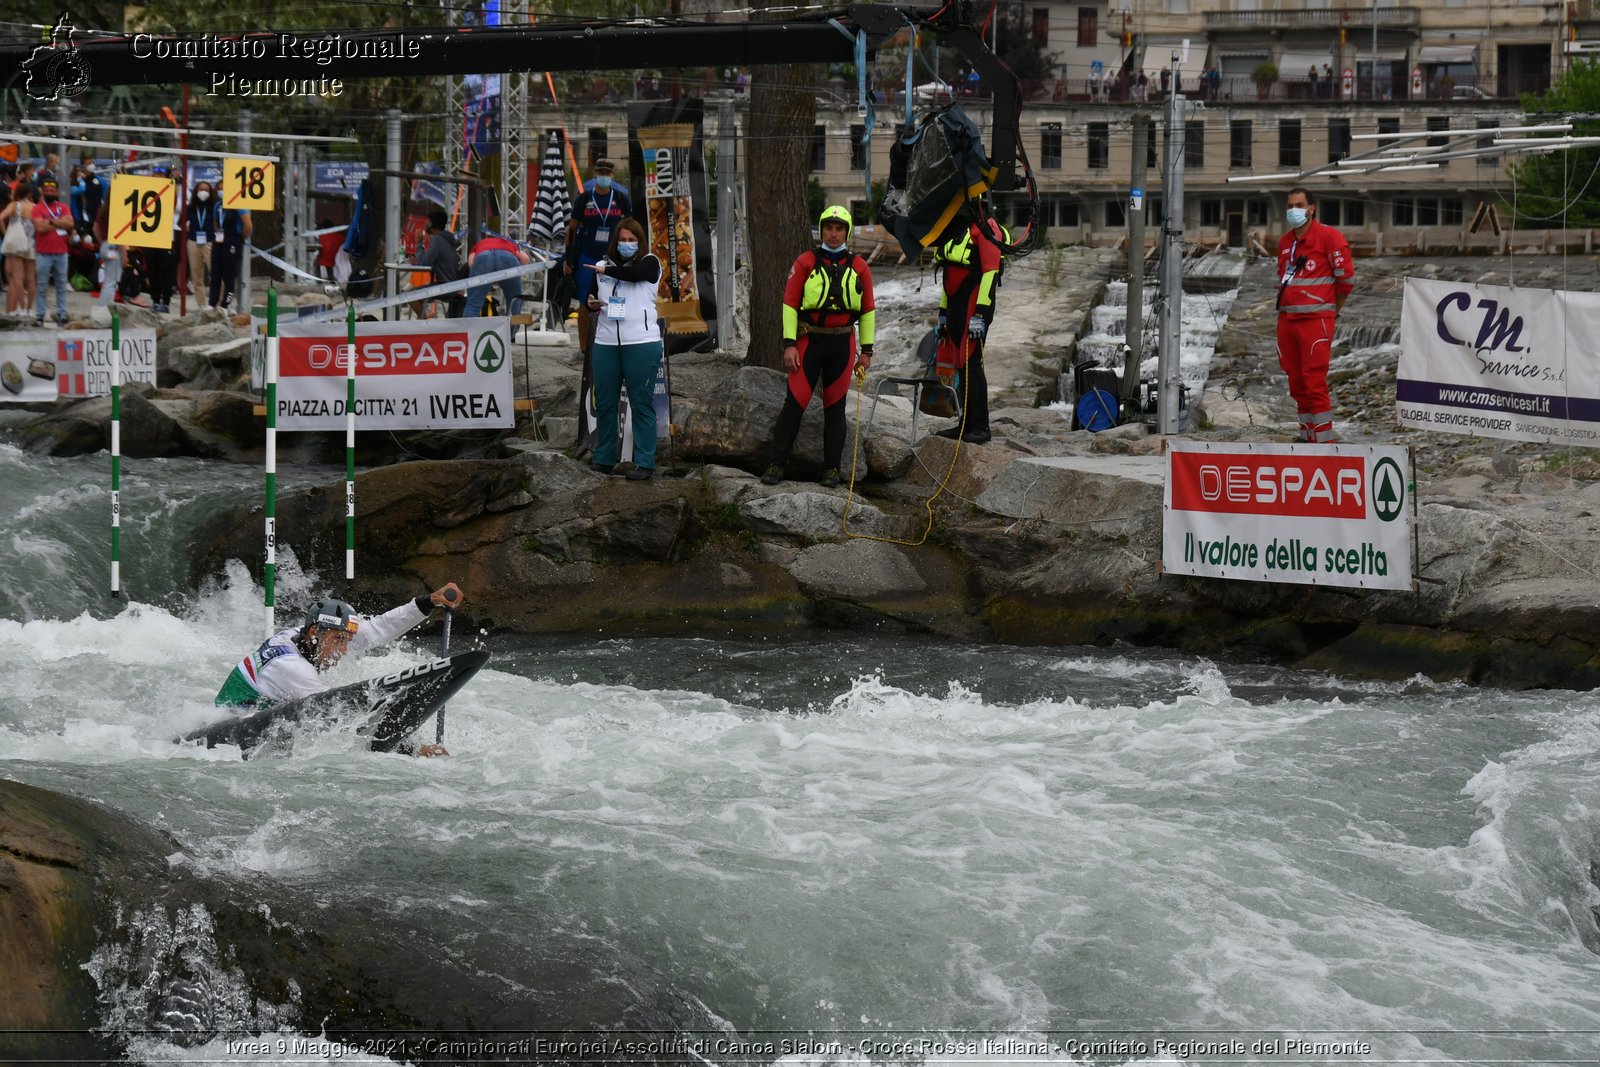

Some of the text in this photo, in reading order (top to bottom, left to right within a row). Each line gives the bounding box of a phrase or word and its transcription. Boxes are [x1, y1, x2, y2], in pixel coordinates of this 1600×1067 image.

[234, 165, 265, 200] 18
[327, 168, 345, 177] ECA
[656, 148, 673, 197] KIND
[123, 188, 162, 234] 19
[583, 208, 622, 217] SLOAKIA
[87, 339, 152, 366] REGONE
[308, 340, 466, 369] DESPAR
[1475, 346, 1541, 378] Service
[278, 400, 330, 417] PIAZZA
[354, 398, 397, 416] CITTA'
[402, 398, 418, 416] 21
[429, 393, 501, 419] IVREA
[1439, 388, 1550, 413] www.cmservicesrl.it
[1401, 408, 1432, 422] GLOBAL
[1434, 412, 1469, 427] SERVICE
[1469, 416, 1512, 431] PROVIDER
[1564, 428, 1598, 440] LOGISTICA
[1200, 464, 1363, 507] DESPAR
[1184, 532, 1388, 576] Il valore della scelta
